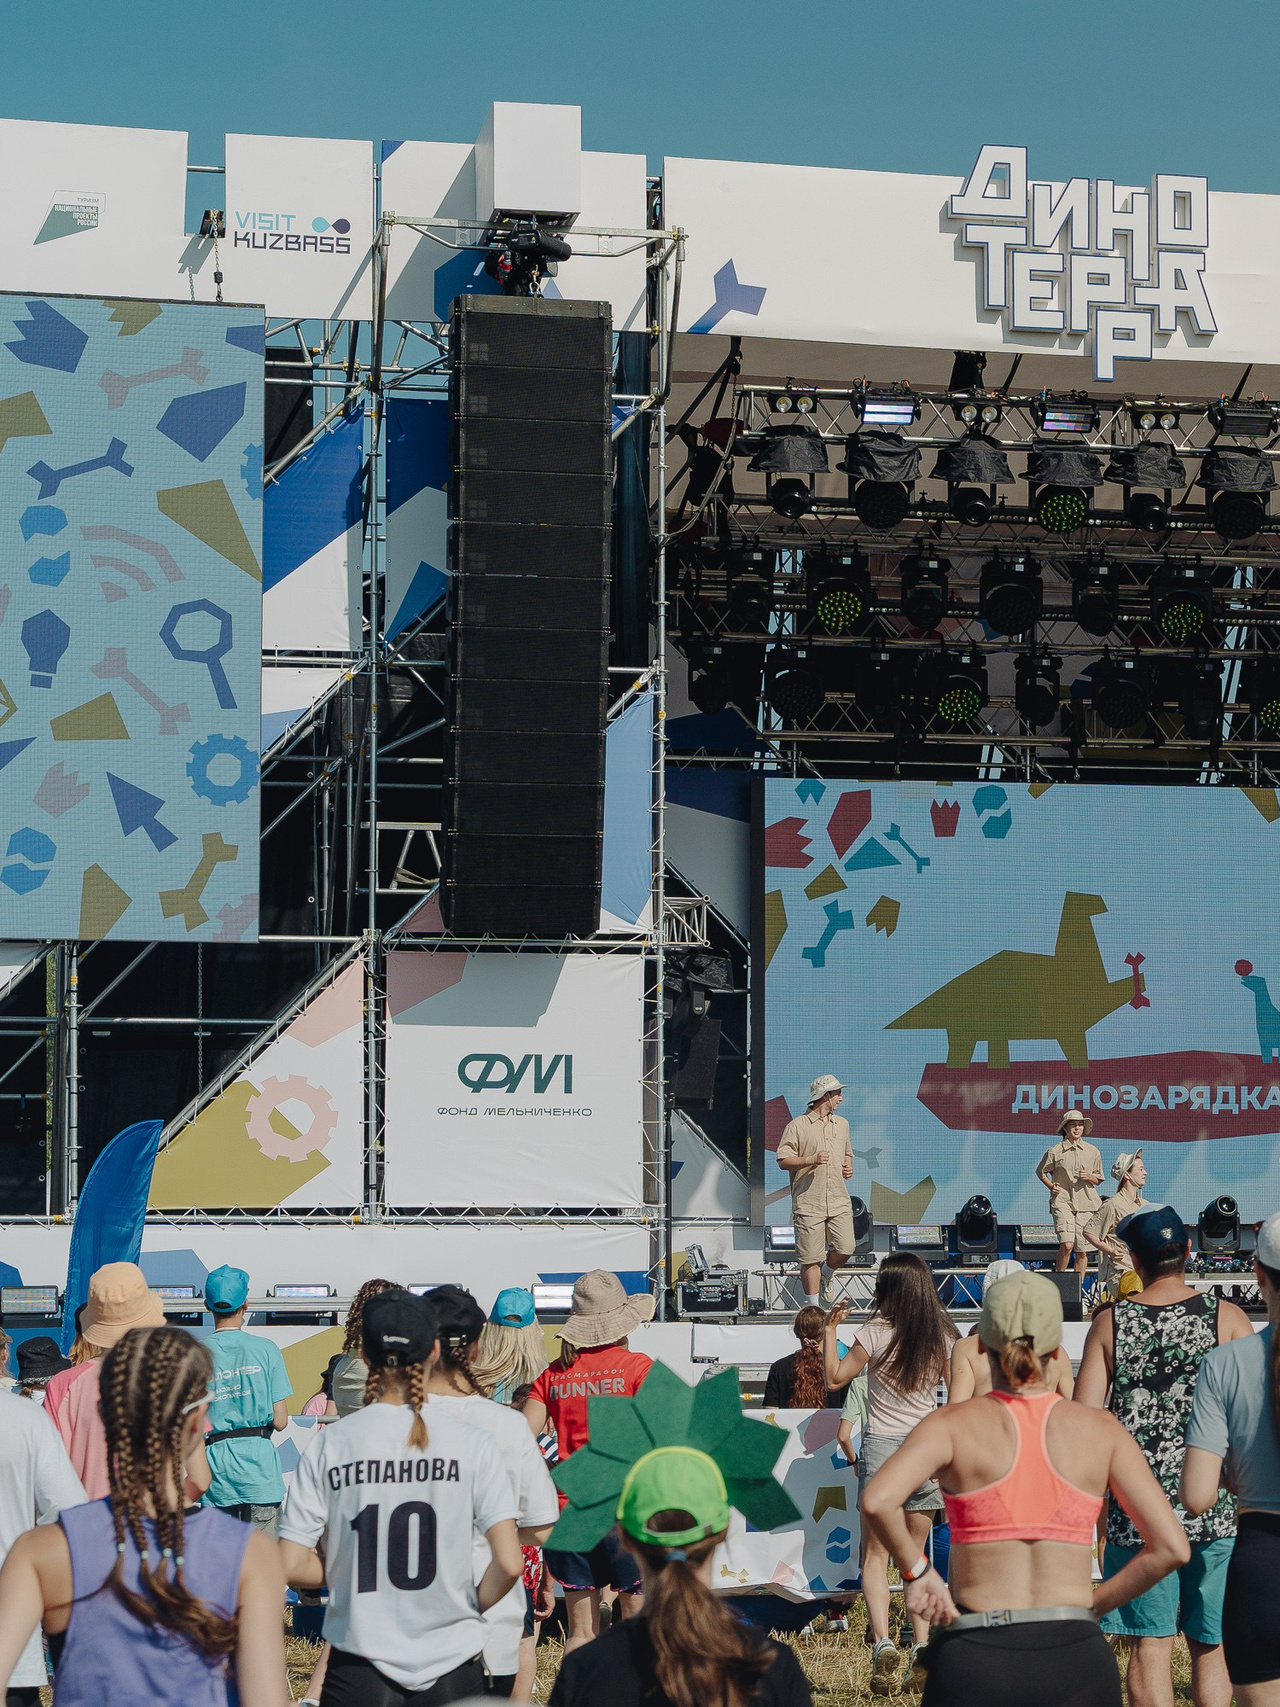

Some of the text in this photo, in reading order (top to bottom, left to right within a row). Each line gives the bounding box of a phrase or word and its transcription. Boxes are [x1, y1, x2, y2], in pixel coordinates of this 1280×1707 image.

[54, 204, 98, 214] НАЦИОНАЛЬНЫЕ
[72, 212, 98, 220] ПРОЕКТЫ
[948, 143, 1209, 282] ДИНО
[77, 218, 98, 227] РОССИИ
[235, 211, 296, 231] VISIT
[234, 231, 350, 254] KUZBASS
[437, 1107, 593, 1117] ФОНД МЕЛЬНИЧЕНКО
[214, 1365, 261, 1380] ЛОНТЕР
[549, 1378, 626, 1400] RUNNER
[328, 1458, 461, 1491] СТЕПАНОВА
[350, 1500, 437, 1594] 10
